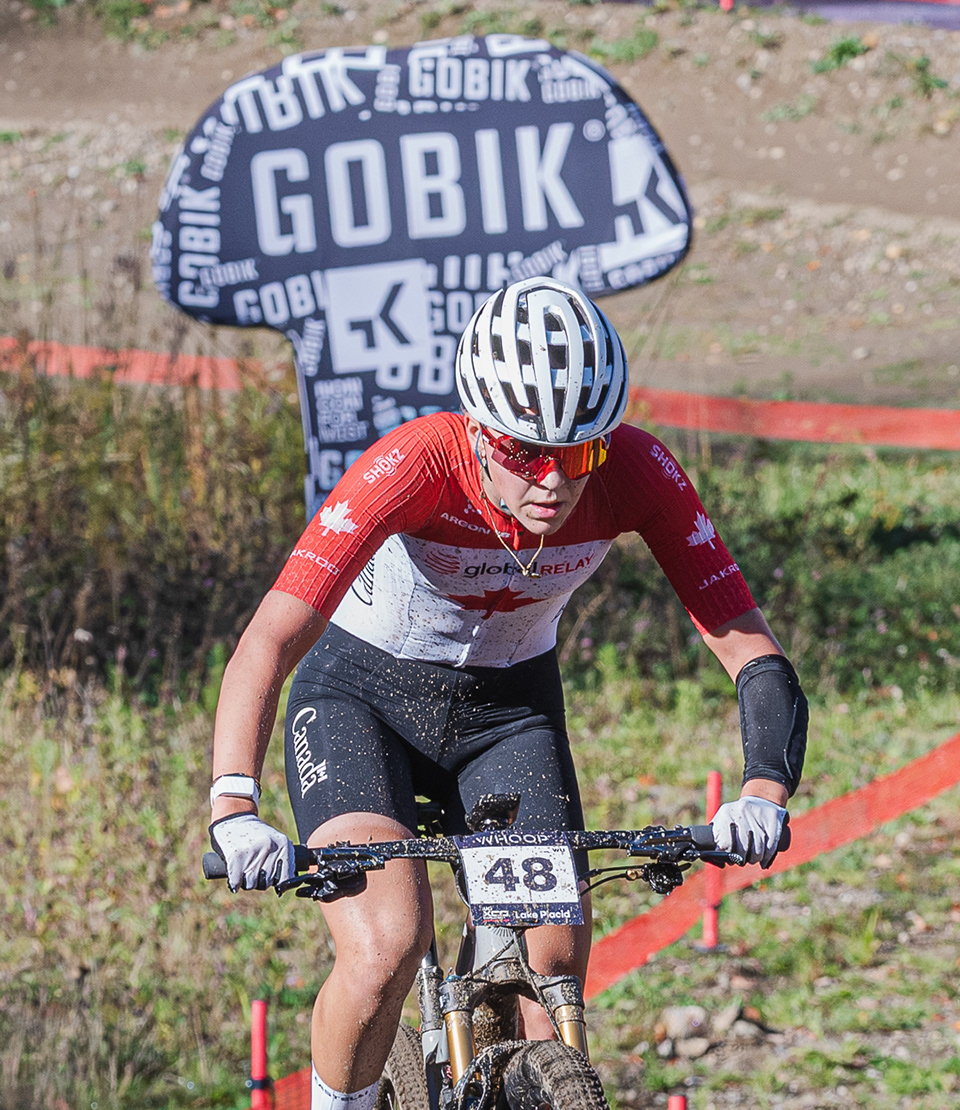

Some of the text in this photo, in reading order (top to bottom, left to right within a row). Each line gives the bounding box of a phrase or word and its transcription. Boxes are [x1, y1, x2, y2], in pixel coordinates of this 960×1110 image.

[408, 49, 531, 102] GOBIK
[251, 122, 585, 257] GOBIK
[233, 269, 328, 328] GOBI
[362, 447, 405, 484] SHOKZ
[650, 444, 687, 491] SHOKZ
[440, 512, 492, 535] ARGON
[289, 549, 341, 576] AKROO
[292, 706, 327, 800] Canada
[475, 834, 548, 846] WHOOP
[484, 856, 558, 892] 48
[515, 910, 539, 919] Lake
